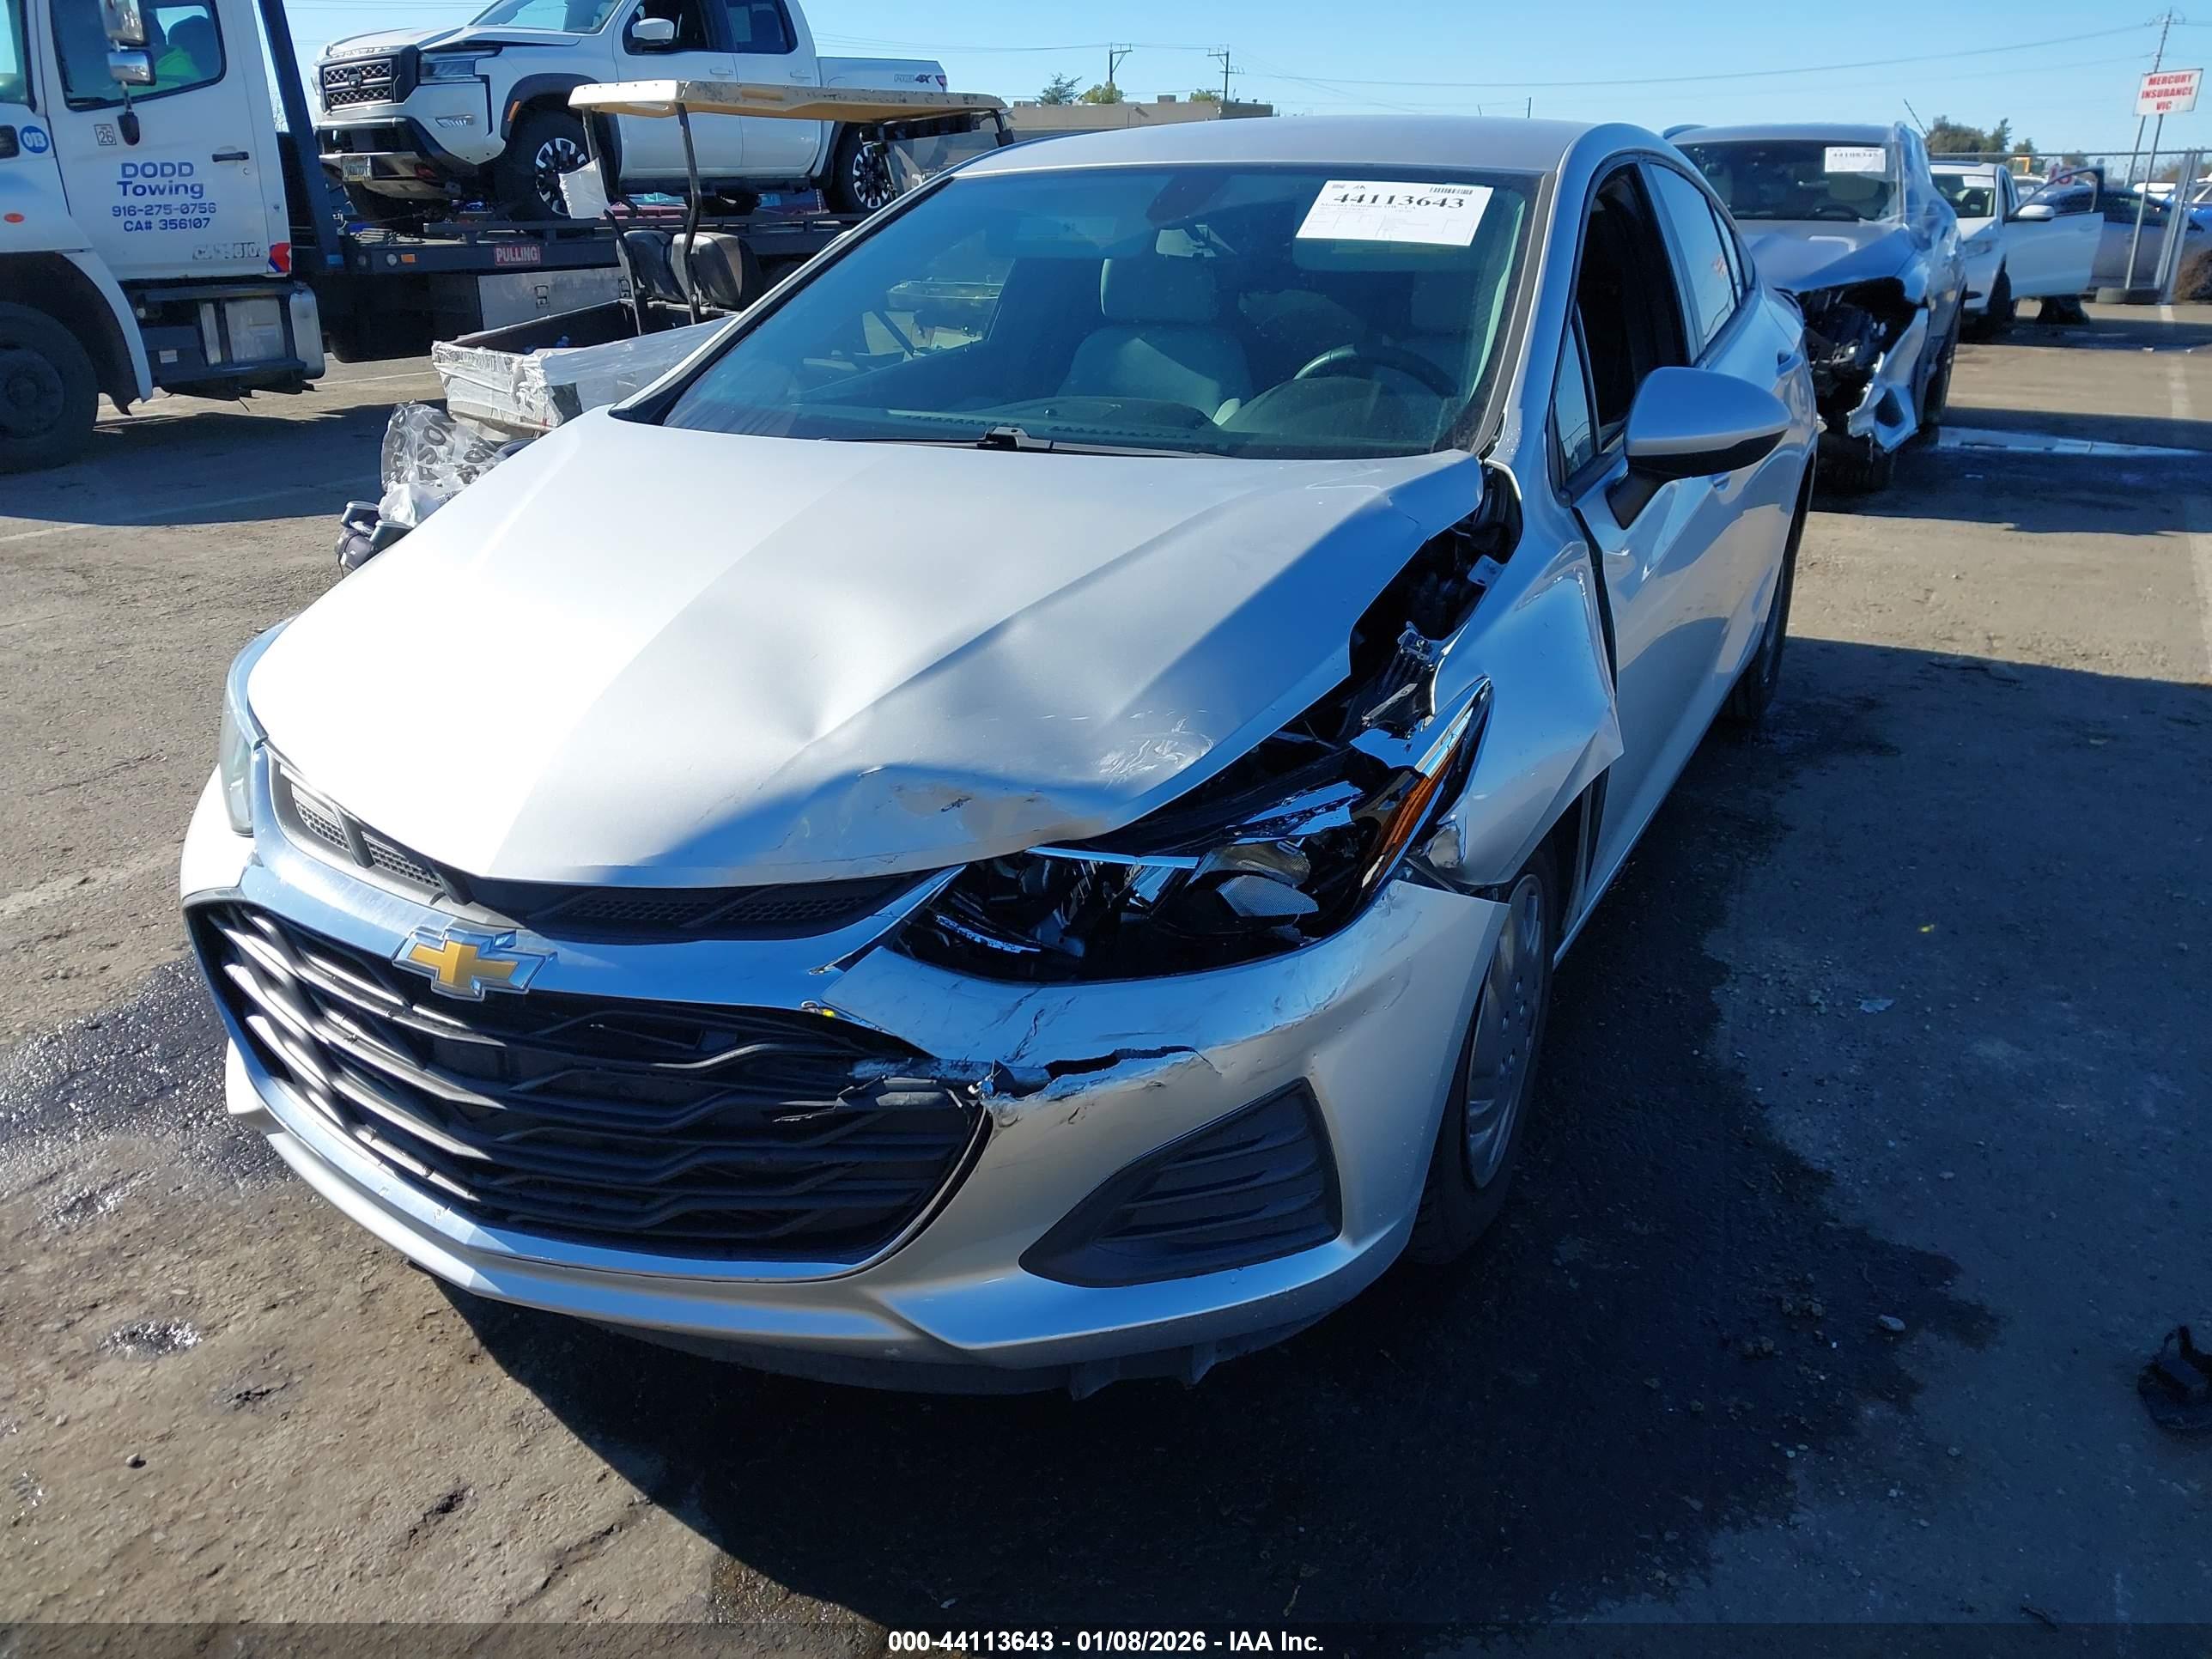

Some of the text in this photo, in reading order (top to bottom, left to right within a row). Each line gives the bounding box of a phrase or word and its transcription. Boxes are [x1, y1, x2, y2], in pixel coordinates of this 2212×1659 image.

[2148, 74, 2194, 86] MERCURY
[2142, 86, 2194, 99] INSURANCE
[2156, 100, 2172, 111] VIC
[98, 131, 114, 144] 26
[120, 161, 195, 179] DODD
[116, 179, 204, 200] Towing
[1333, 192, 1465, 209] 44113643
[112, 203, 217, 217] 916-275-0756
[123, 217, 211, 233] CA# 356107
[496, 246, 538, 262] PULLING
